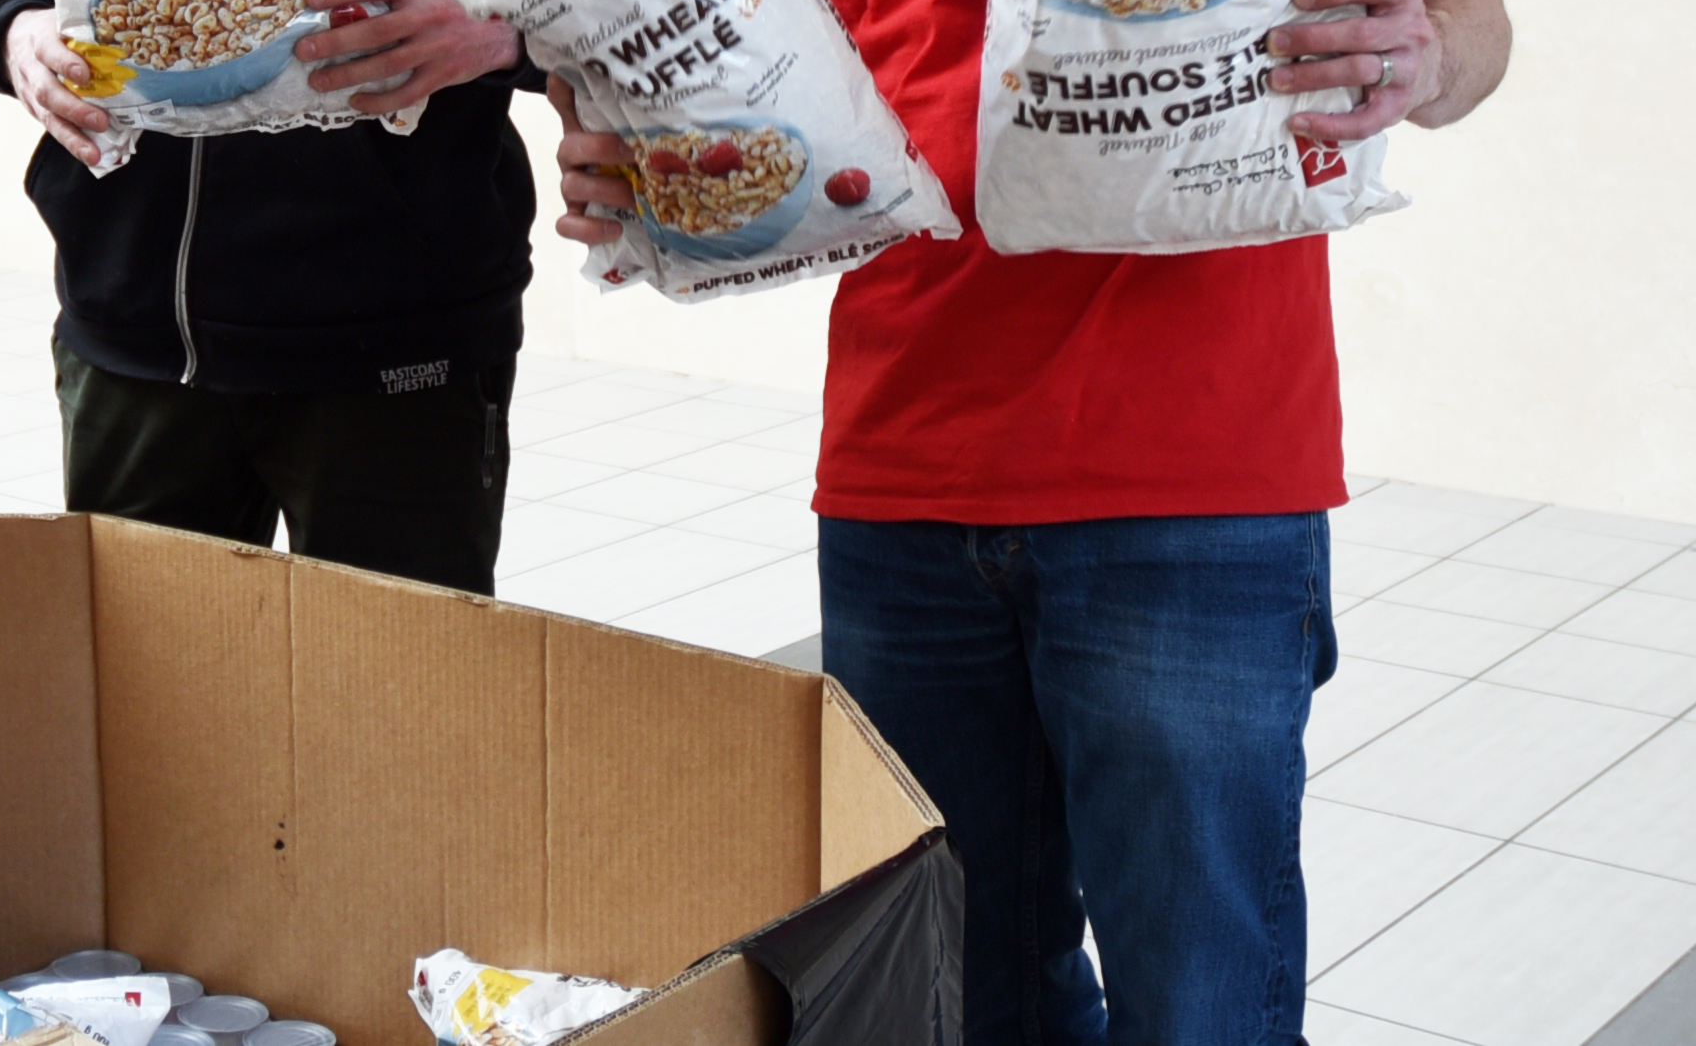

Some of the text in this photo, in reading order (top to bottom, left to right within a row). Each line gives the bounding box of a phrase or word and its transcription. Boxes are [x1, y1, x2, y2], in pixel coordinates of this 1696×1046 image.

[574, 1, 647, 53] Natural
[628, 14, 742, 98] UFFLÉ
[1054, 48, 1132, 71] naturel
[1027, 60, 1207, 105] SOUFFLÉ
[1012, 100, 1153, 135] WHEAT
[1098, 117, 1227, 156] All Natural
[693, 271, 756, 294] PUFFED
[758, 254, 817, 281] WHEAT
[827, 242, 859, 264] BLÉ
[380, 359, 450, 383] EASTCOAST
[387, 372, 448, 395] LIFESTYLE
